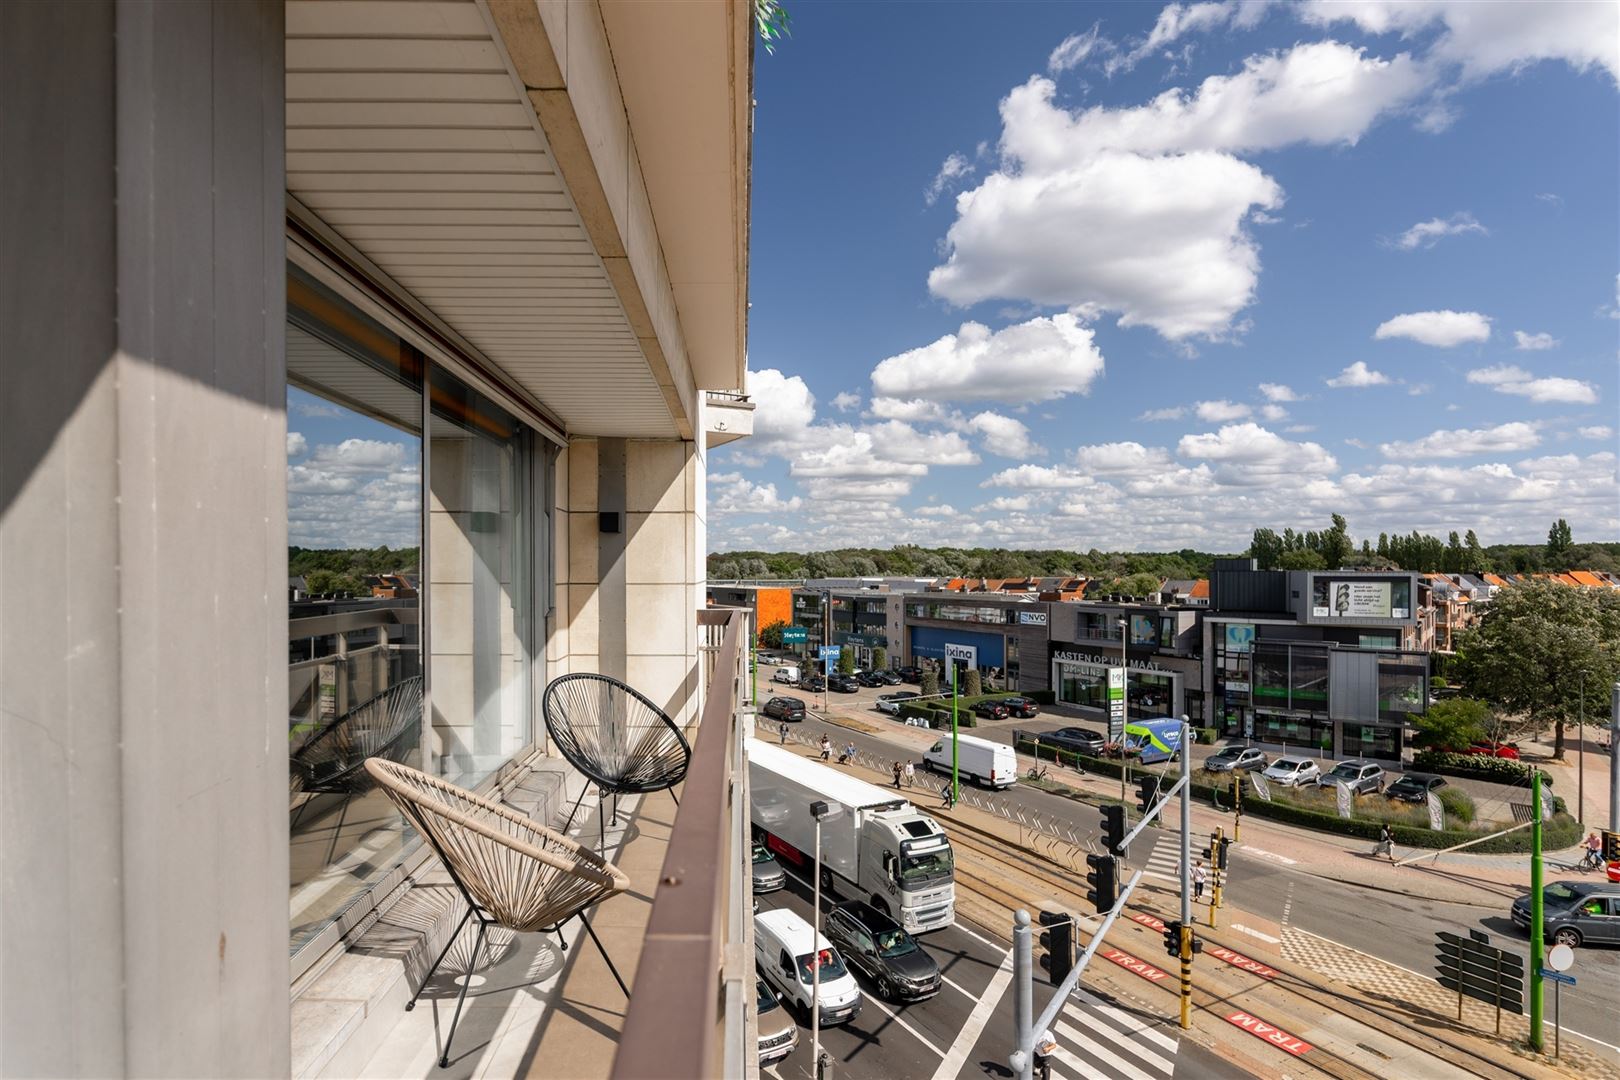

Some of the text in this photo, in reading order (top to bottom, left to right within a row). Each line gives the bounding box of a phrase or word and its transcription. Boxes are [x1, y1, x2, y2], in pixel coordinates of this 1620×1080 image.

[1028, 613, 1046, 622] NVO
[946, 646, 972, 659] ixina
[1054, 650, 1092, 663] KASTEN
[1093, 655, 1108, 665] OP
[1130, 659, 1160, 671] MAAT
[1109, 951, 1163, 980] TRAM
[1213, 949, 1273, 977] TRAM
[1230, 1014, 1303, 1053] TRAM
